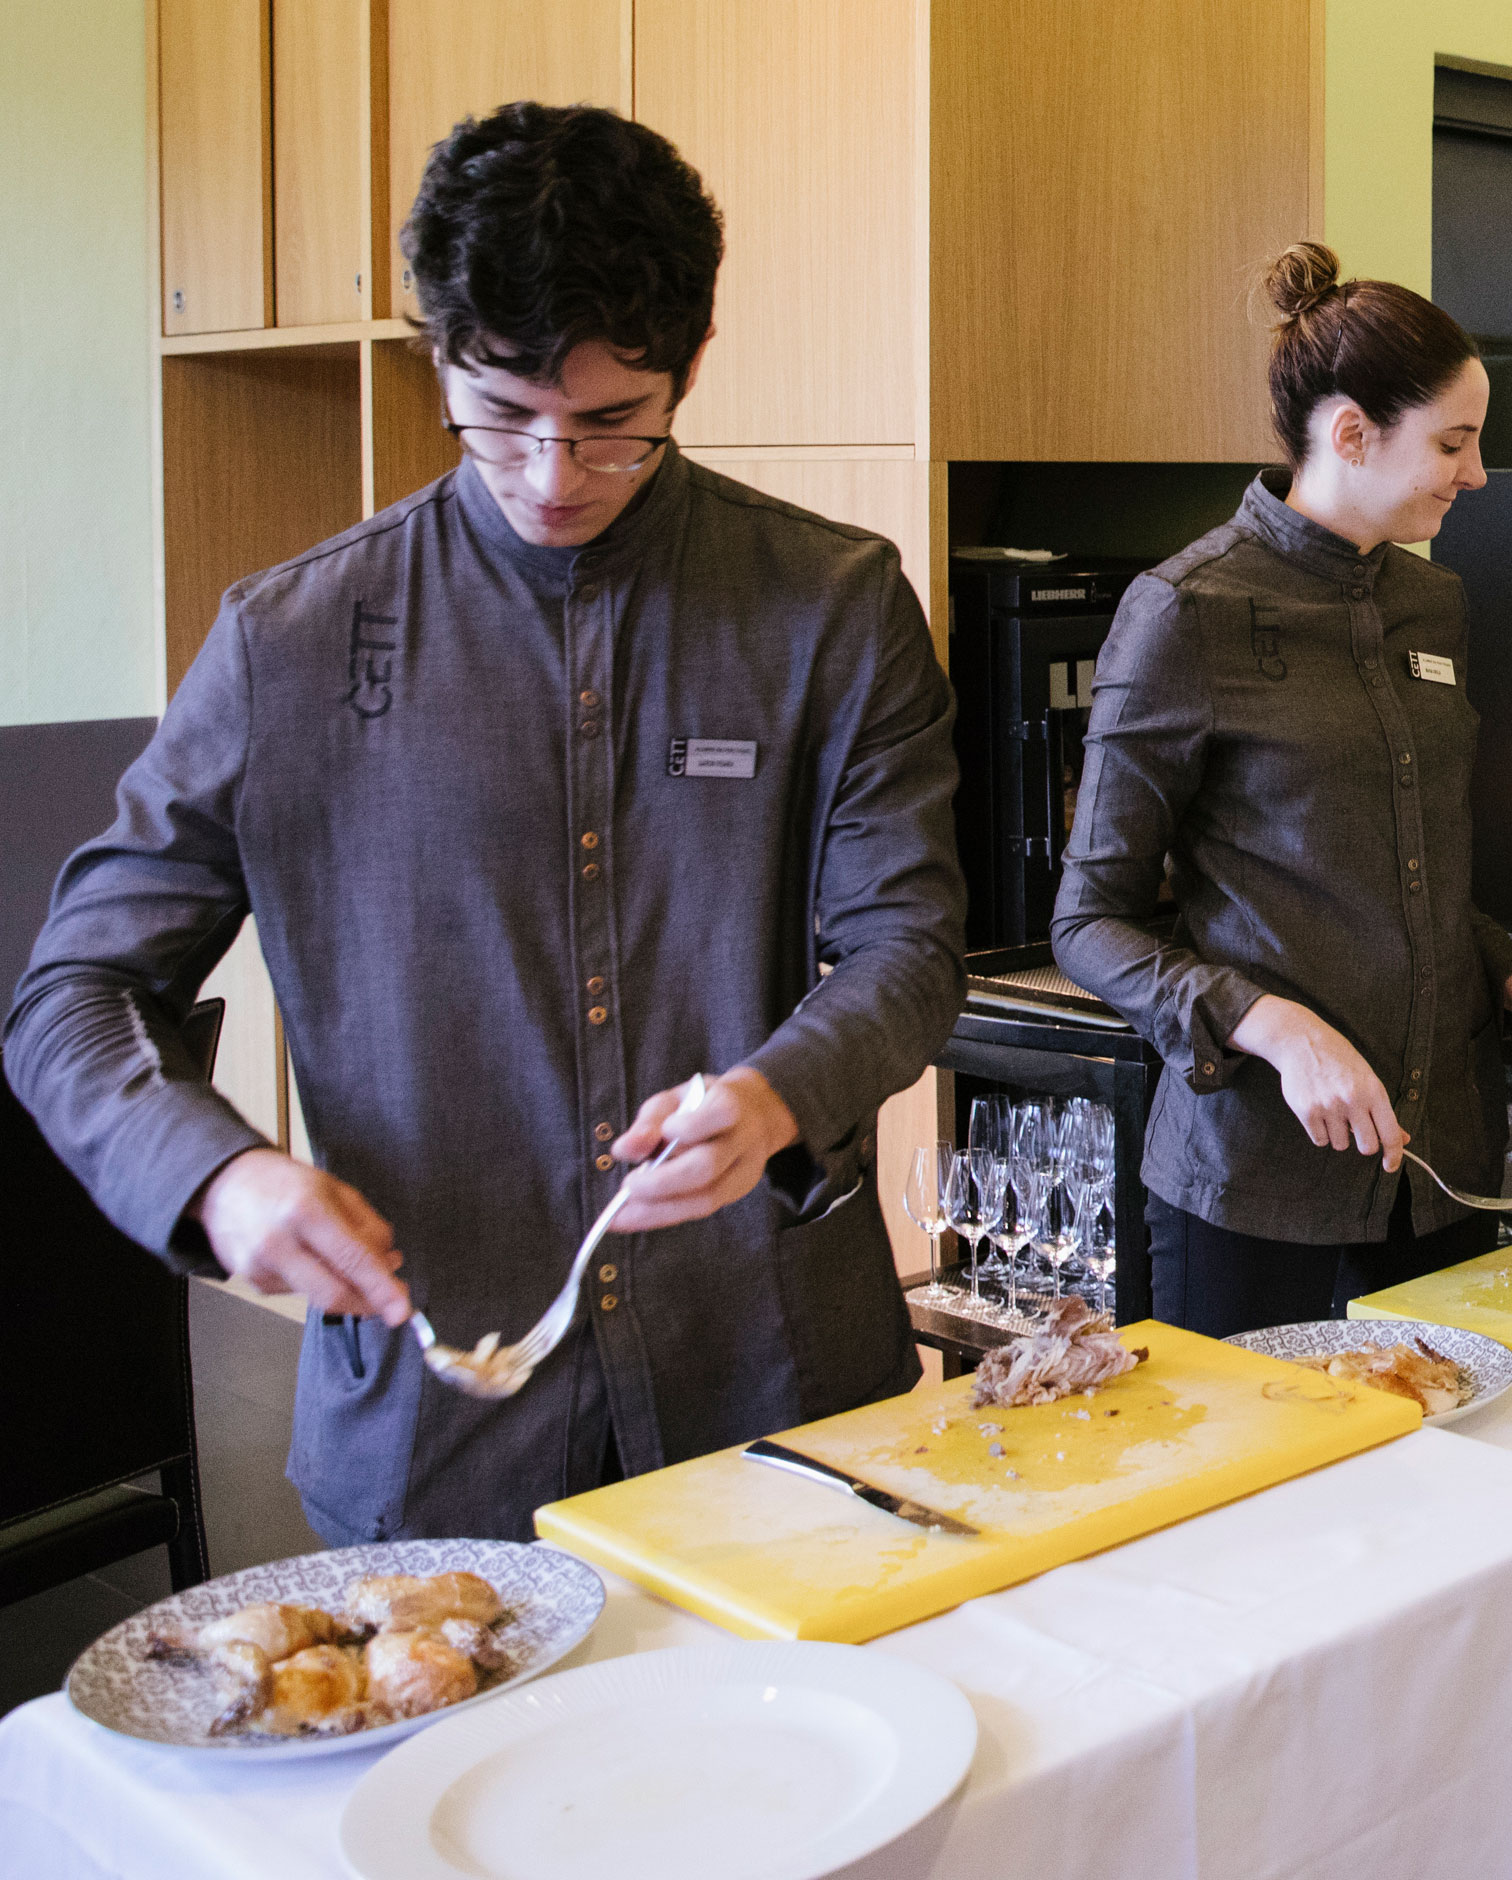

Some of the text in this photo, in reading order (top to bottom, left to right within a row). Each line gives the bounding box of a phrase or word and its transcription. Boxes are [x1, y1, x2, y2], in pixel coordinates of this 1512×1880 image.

[1031, 588, 1086, 602] LIEBHERR
[1249, 597, 1287, 681] CETT
[341, 600, 398, 719] CETT
[1408, 650, 1421, 678] CETT
[668, 738, 687, 776] CETT
